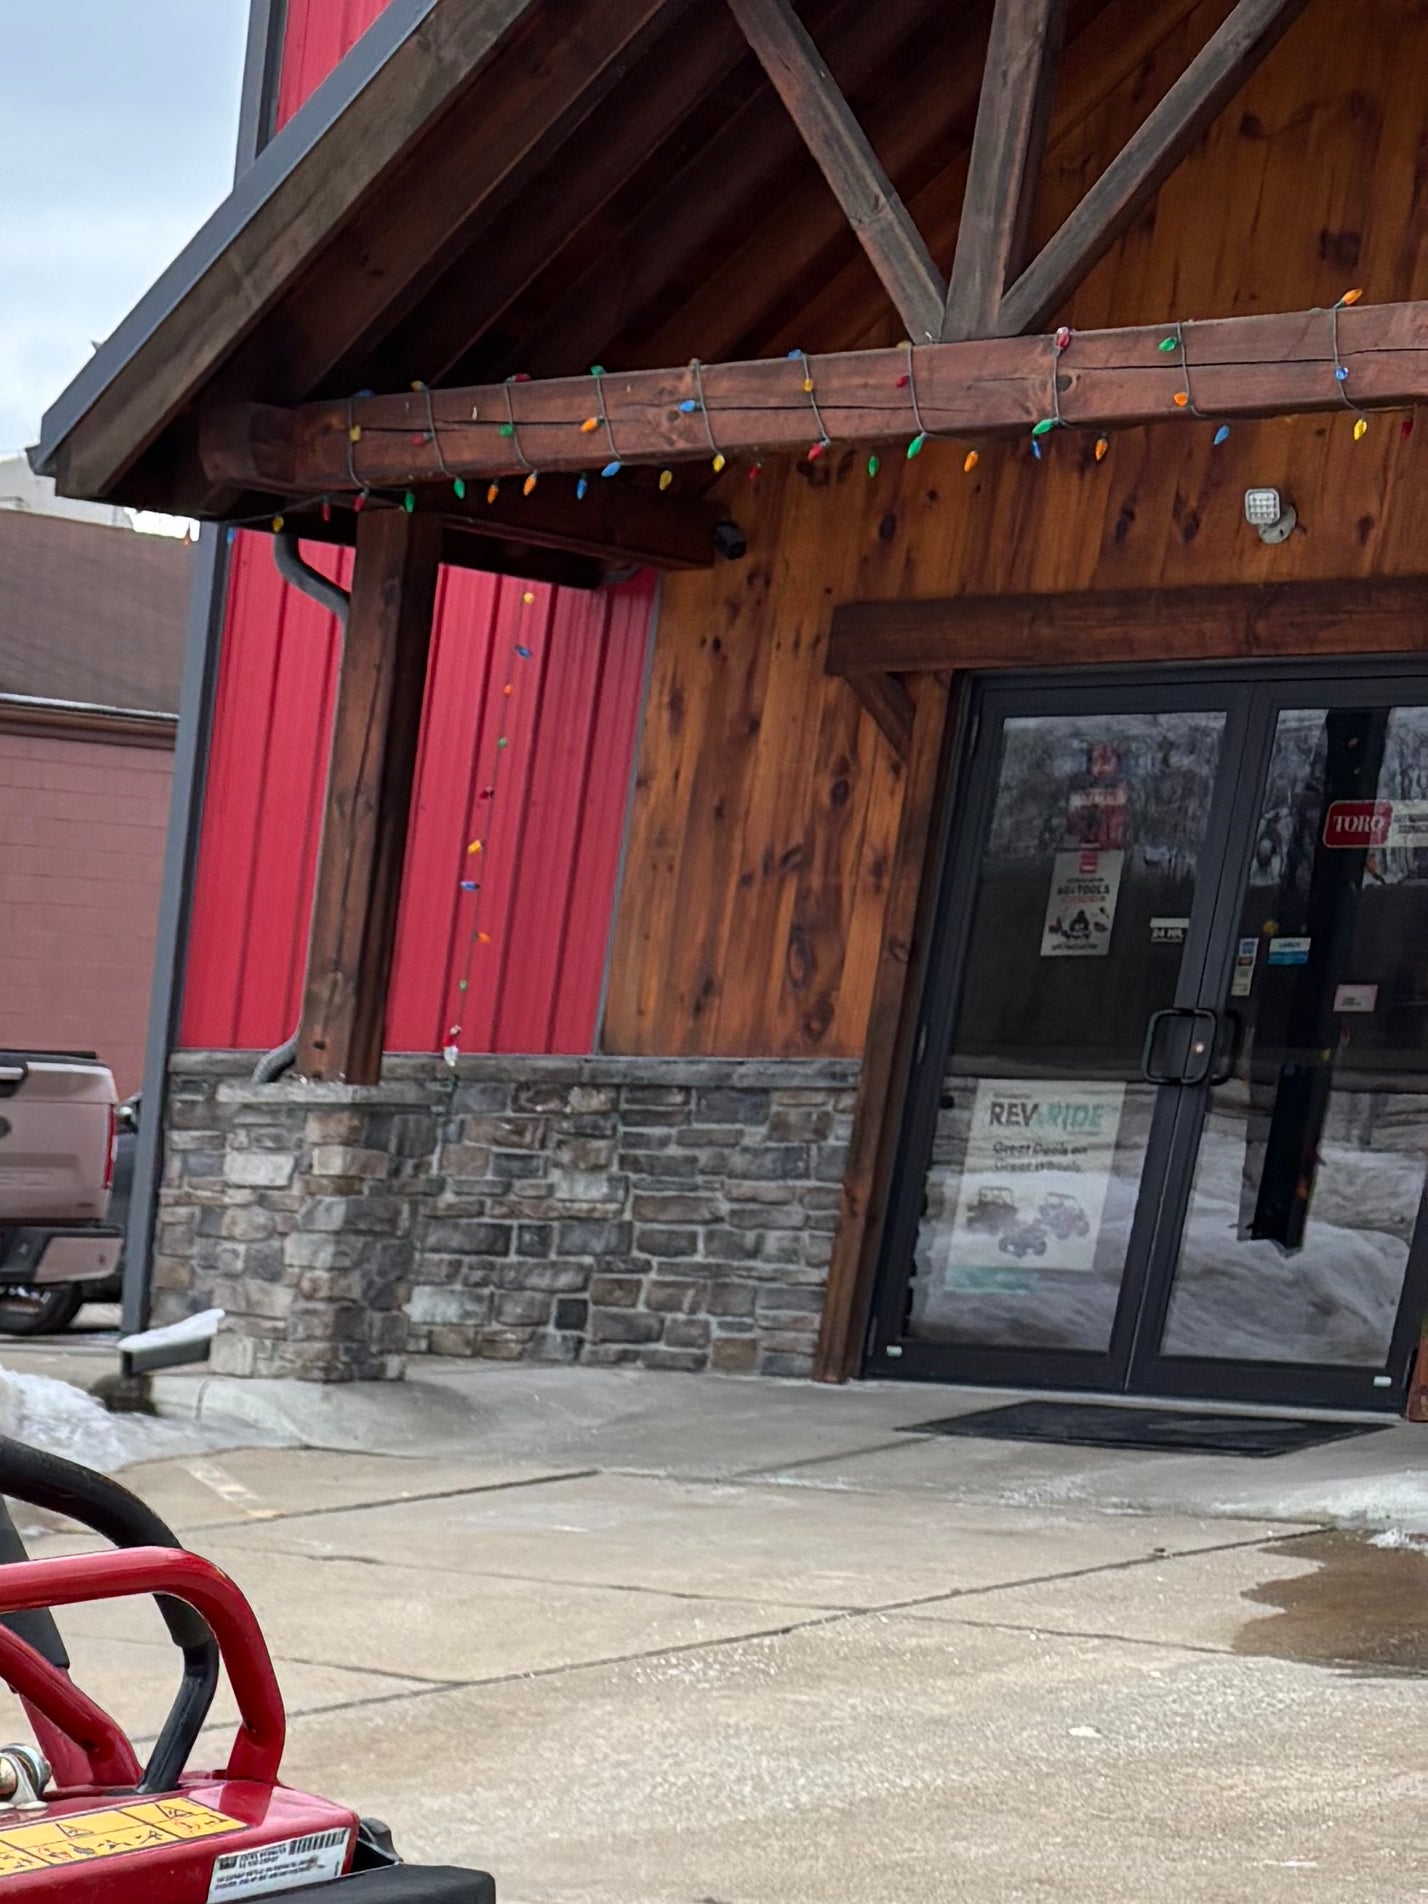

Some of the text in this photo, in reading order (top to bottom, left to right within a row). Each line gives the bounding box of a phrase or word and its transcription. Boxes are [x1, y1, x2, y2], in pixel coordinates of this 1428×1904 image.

[1333, 815, 1386, 834] TORO
[990, 1102, 1039, 1127] REV
[1047, 1102, 1104, 1130] RIDE
